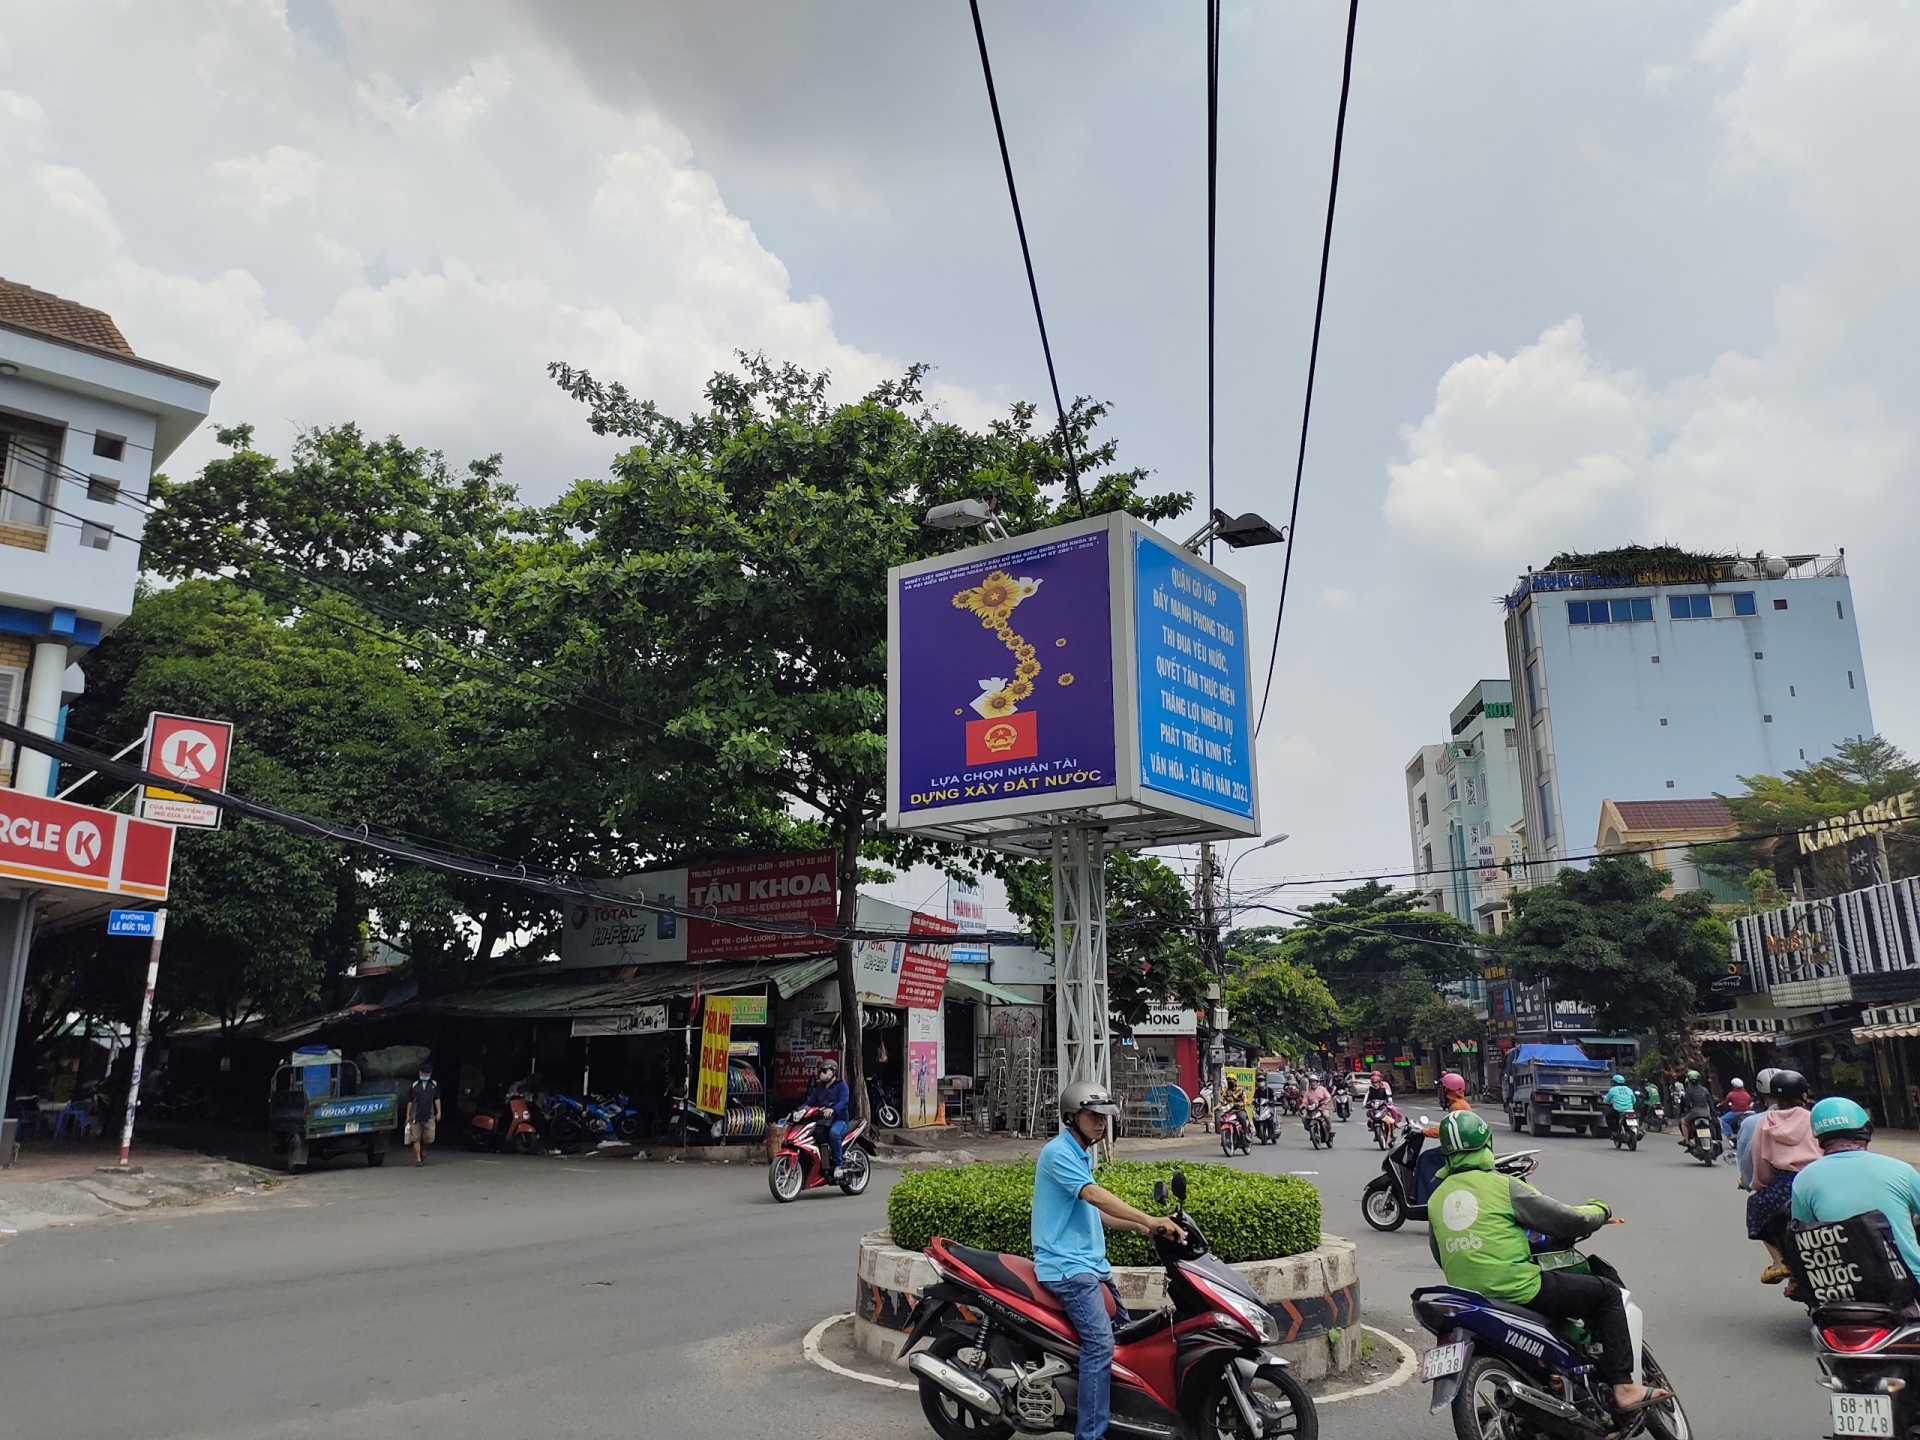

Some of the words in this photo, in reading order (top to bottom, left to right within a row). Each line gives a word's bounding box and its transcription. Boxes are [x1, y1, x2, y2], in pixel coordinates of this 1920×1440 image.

[1172, 567, 1190, 594] QUẬN
[1193, 578, 1202, 599] GÒ
[1203, 583, 1217, 607] VẤP
[1153, 583, 1168, 612] ĐẨY
[1171, 598, 1191, 624] MẠNH
[1193, 610, 1216, 637] PHONG
[1217, 623, 1234, 646] TRÀO
[1162, 625, 1175, 648] THI
[1177, 632, 1191, 656] ĐUA
[1193, 638, 1207, 663] YÊU
[1156, 655, 1180, 682] QUYẾT
[1182, 664, 1198, 690] TÂM
[1200, 674, 1218, 700] THỰC
[1220, 683, 1236, 708] HIỆN
[1161, 686, 1186, 716] THẮNG
[1188, 701, 1199, 724] LỢI
[1201, 707, 1223, 732] NHIỆM
[1224, 716, 1233, 739] VỤ
[1160, 722, 1180, 747] PHÁT
[1182, 726, 1204, 755] TRIỂN
[1205, 739, 1222, 762] KINH
[1223, 742, 1232, 766] TẾ
[931, 776, 959, 787] LỰA
[963, 769, 1003, 782] CHỌN
[1008, 762, 1048, 776] NHÂN
[1053, 758, 1077, 770] TÀI
[1150, 752, 1166, 776] VĂN
[1168, 756, 1184, 782] HÓA
[1190, 764, 1200, 786] XÃ
[1202, 768, 1214, 793] HỘI
[1216, 774, 1230, 796] NĂM
[1232, 782, 1248, 802] 2021
[910, 788, 959, 805] DỰNG
[964, 782, 999, 797] XÂY
[1003, 777, 1039, 792] ĐẤT
[1045, 770, 1101, 786] NƯỚC
[1798, 791, 1916, 854] KARAOKE
[713, 868, 725, 876] TÂM
[737, 865, 757, 873] THUẬT
[796, 856, 805, 865] TỬ
[817, 854, 831, 863] MÁY
[690, 878, 741, 906] TẤN
[749, 873, 831, 900] KHOA
[112, 922, 121, 931] LÊ
[121, 920, 136, 931] ĐỨC
[136, 922, 151, 933] THỌ
[593, 906, 638, 921] TOTAL
[591, 924, 647, 946] HI-PERF
[712, 938, 721, 946] UY
[736, 934, 753, 944] CHẤT
[1813, 1116, 1849, 1130] BAEMIN
[1446, 1232, 1482, 1253] Grab
[1795, 1225, 1848, 1250] NƯỚC
[1800, 1245, 1843, 1270] SÔI!
[1807, 1263, 1863, 1289] NƯỚC
[1429, 1345, 1457, 1363] 93-F1
[1504, 1329, 1545, 1358] YAMAHA
[1837, 1415, 1888, 1433] 302.48
